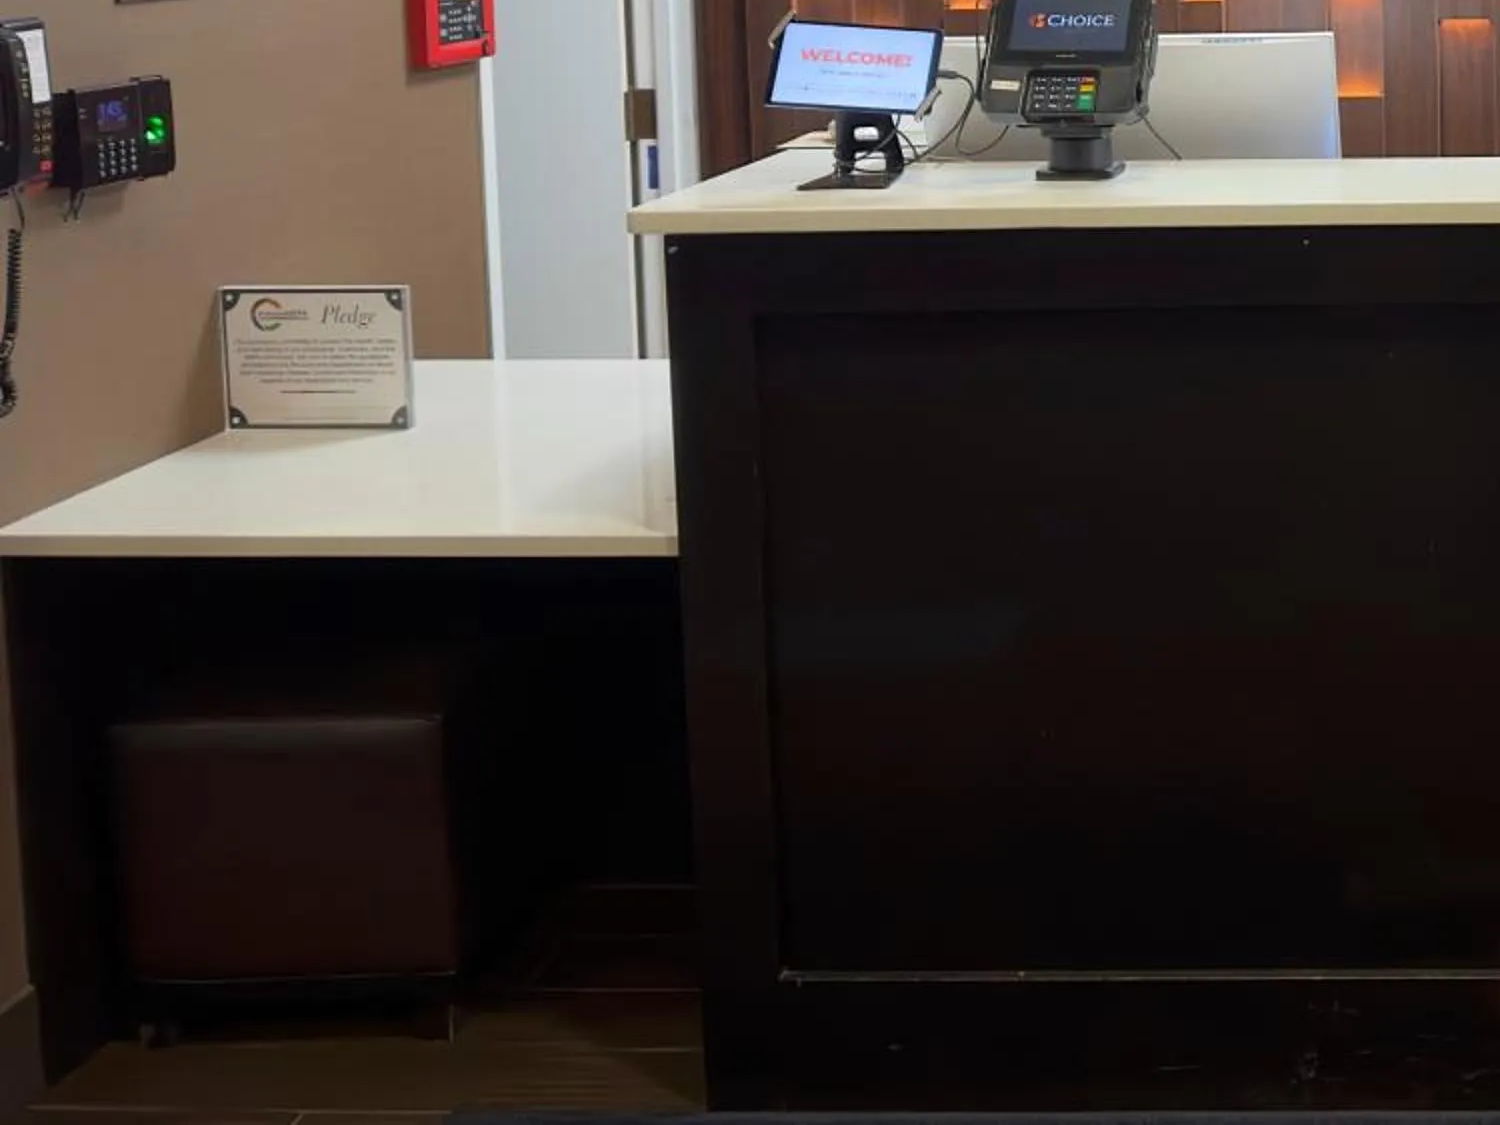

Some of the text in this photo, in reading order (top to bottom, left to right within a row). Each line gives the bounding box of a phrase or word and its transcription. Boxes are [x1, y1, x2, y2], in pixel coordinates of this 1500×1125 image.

[1048, 14, 1115, 27] CHOICE
[800, 48, 913, 68] WELCOME!
[321, 303, 377, 329] Pledge
